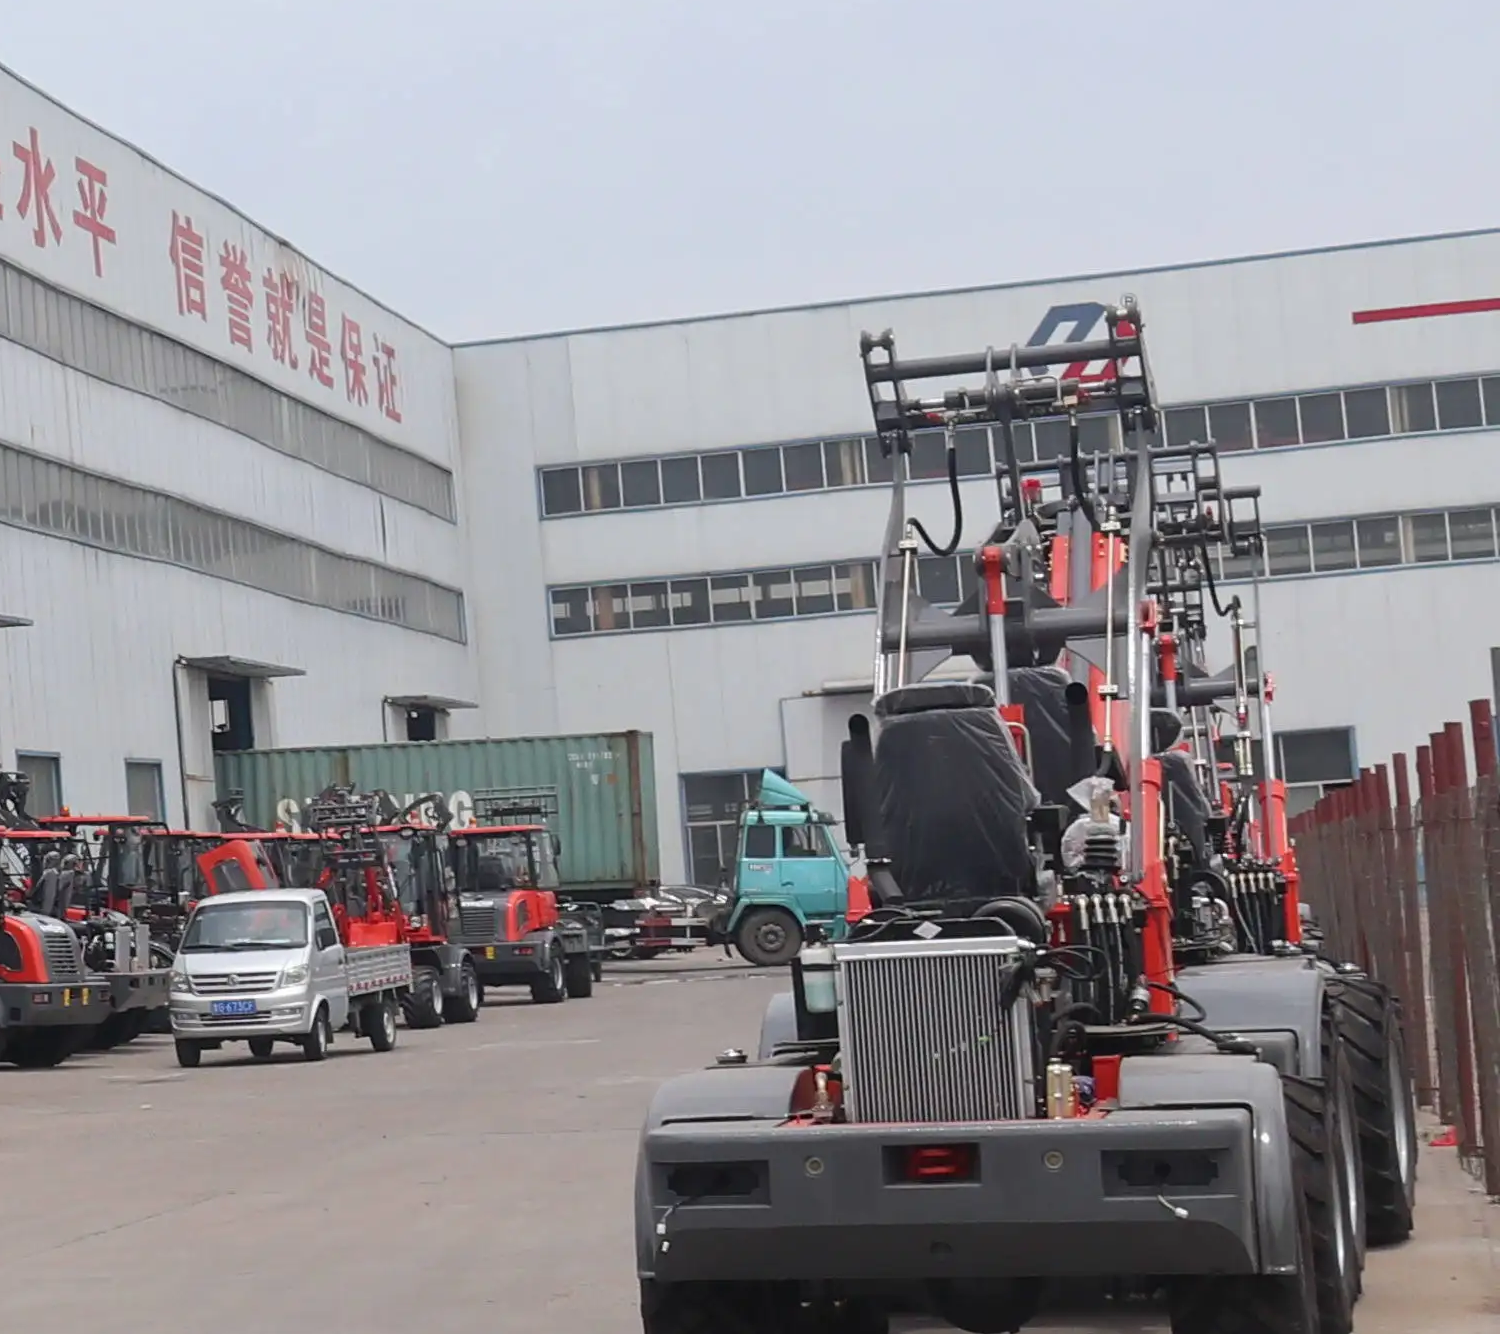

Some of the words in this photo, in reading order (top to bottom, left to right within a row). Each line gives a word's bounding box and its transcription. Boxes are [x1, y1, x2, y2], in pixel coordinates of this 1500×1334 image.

[169, 208, 403, 424] 信誉就是保证
